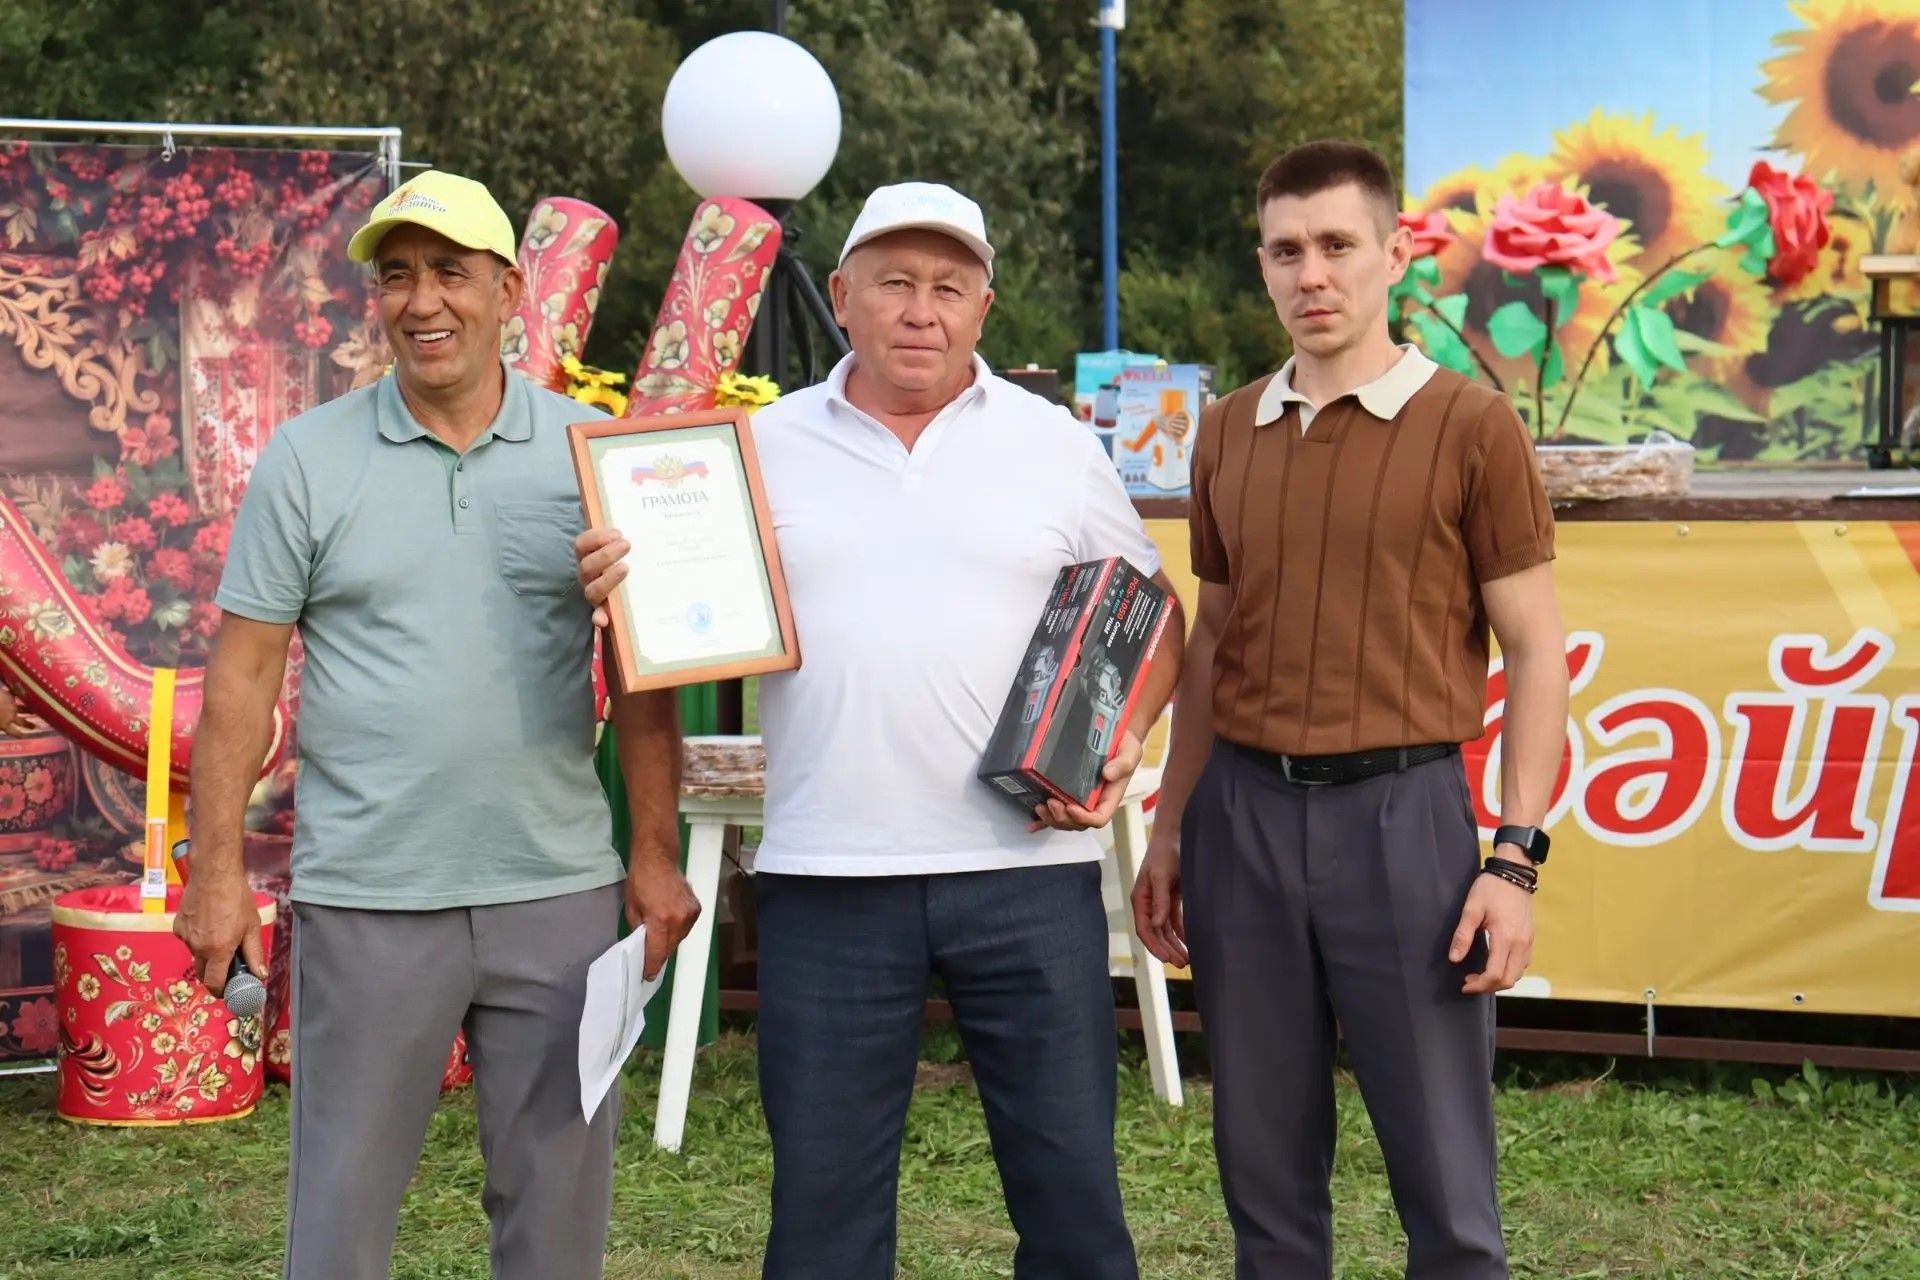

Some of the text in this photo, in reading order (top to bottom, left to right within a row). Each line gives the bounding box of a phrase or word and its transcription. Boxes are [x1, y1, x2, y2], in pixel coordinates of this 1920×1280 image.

[641, 490, 709, 508] ГРАМОТА
[1117, 576, 1139, 620] PGS-1050
[1103, 616, 1114, 635] УШМ
